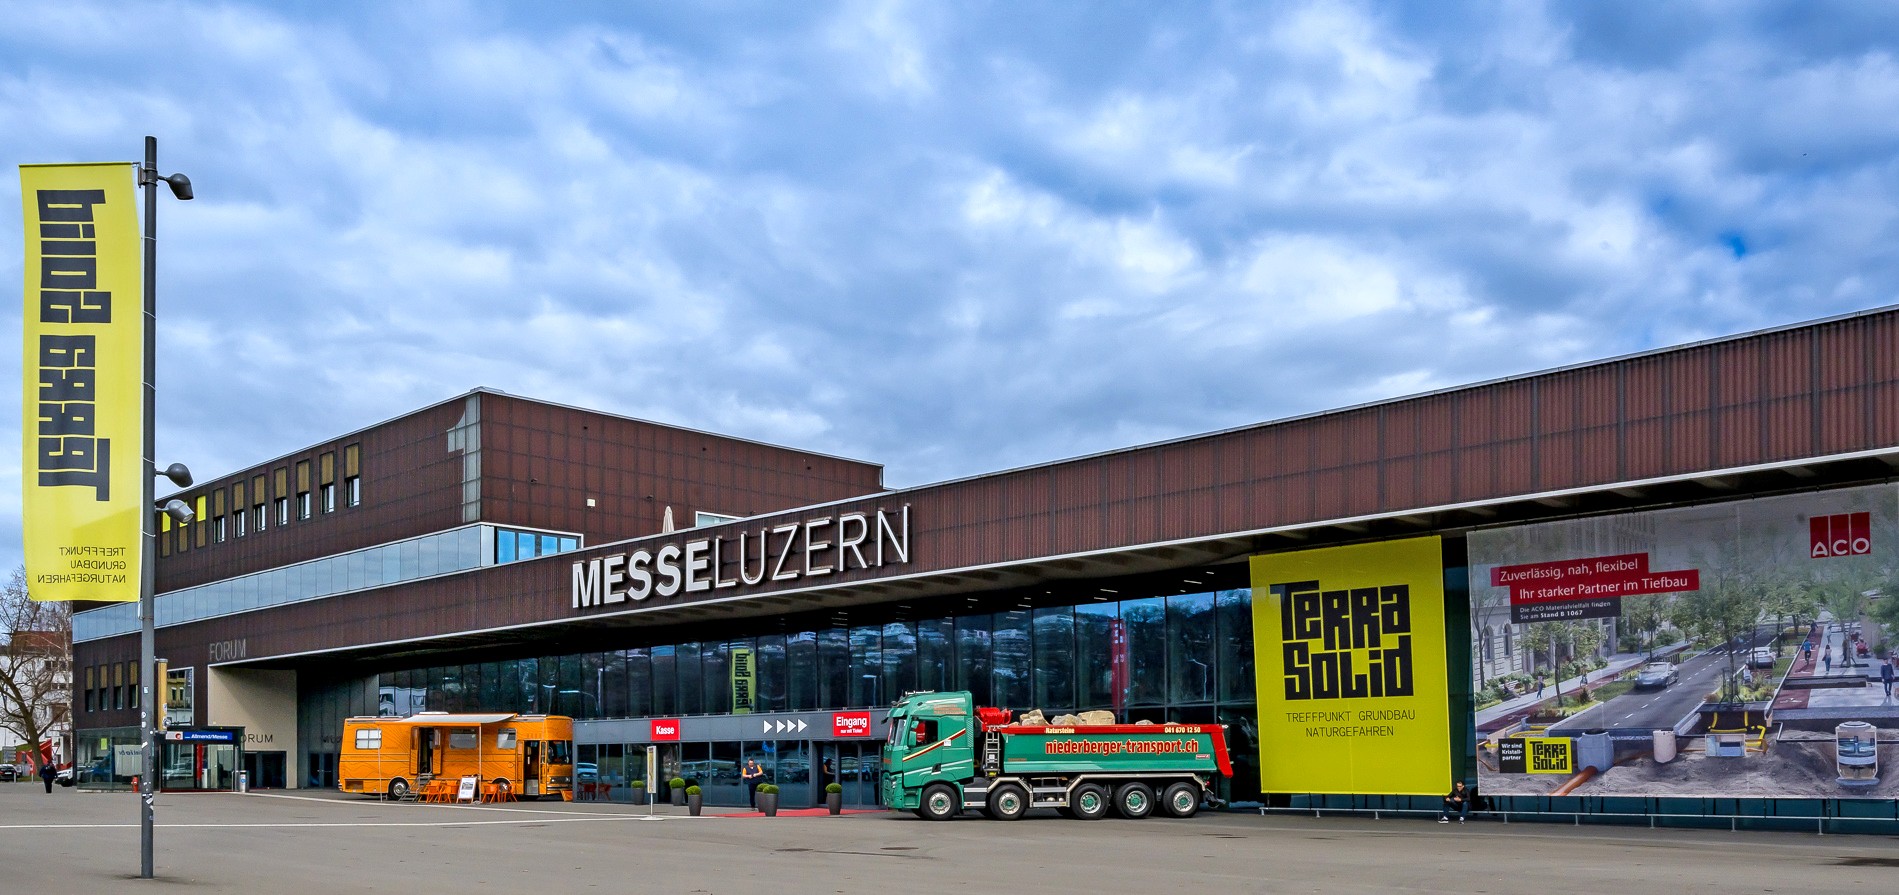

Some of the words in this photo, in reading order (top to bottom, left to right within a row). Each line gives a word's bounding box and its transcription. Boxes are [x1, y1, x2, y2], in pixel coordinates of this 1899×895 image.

[1812, 537, 1870, 557] ACO
[1500, 567, 1564, 582] Zuverlässig,
[1568, 565, 1593, 576] nah,
[1596, 558, 1638, 573] flexibel
[1520, 588, 1535, 600] Ihr
[1537, 586, 1575, 599] starker
[1578, 582, 1620, 595] Partner
[1623, 580, 1638, 591] im
[1641, 576, 1688, 589] Tiefbau
[1545, 602, 1591, 611] Materialvielfalt
[209, 638, 247, 662] FORUM
[836, 716, 868, 728] Eingang
[1286, 711, 1352, 723] TREFFPUNKT
[1358, 709, 1416, 721] GRUNDBAU
[656, 725, 675, 735] Kasse
[1305, 725, 1394, 738] NATURGEFAHREN
[240, 733, 274, 744] ORUM
[1045, 738, 1199, 756] niederberger-transport.ch
